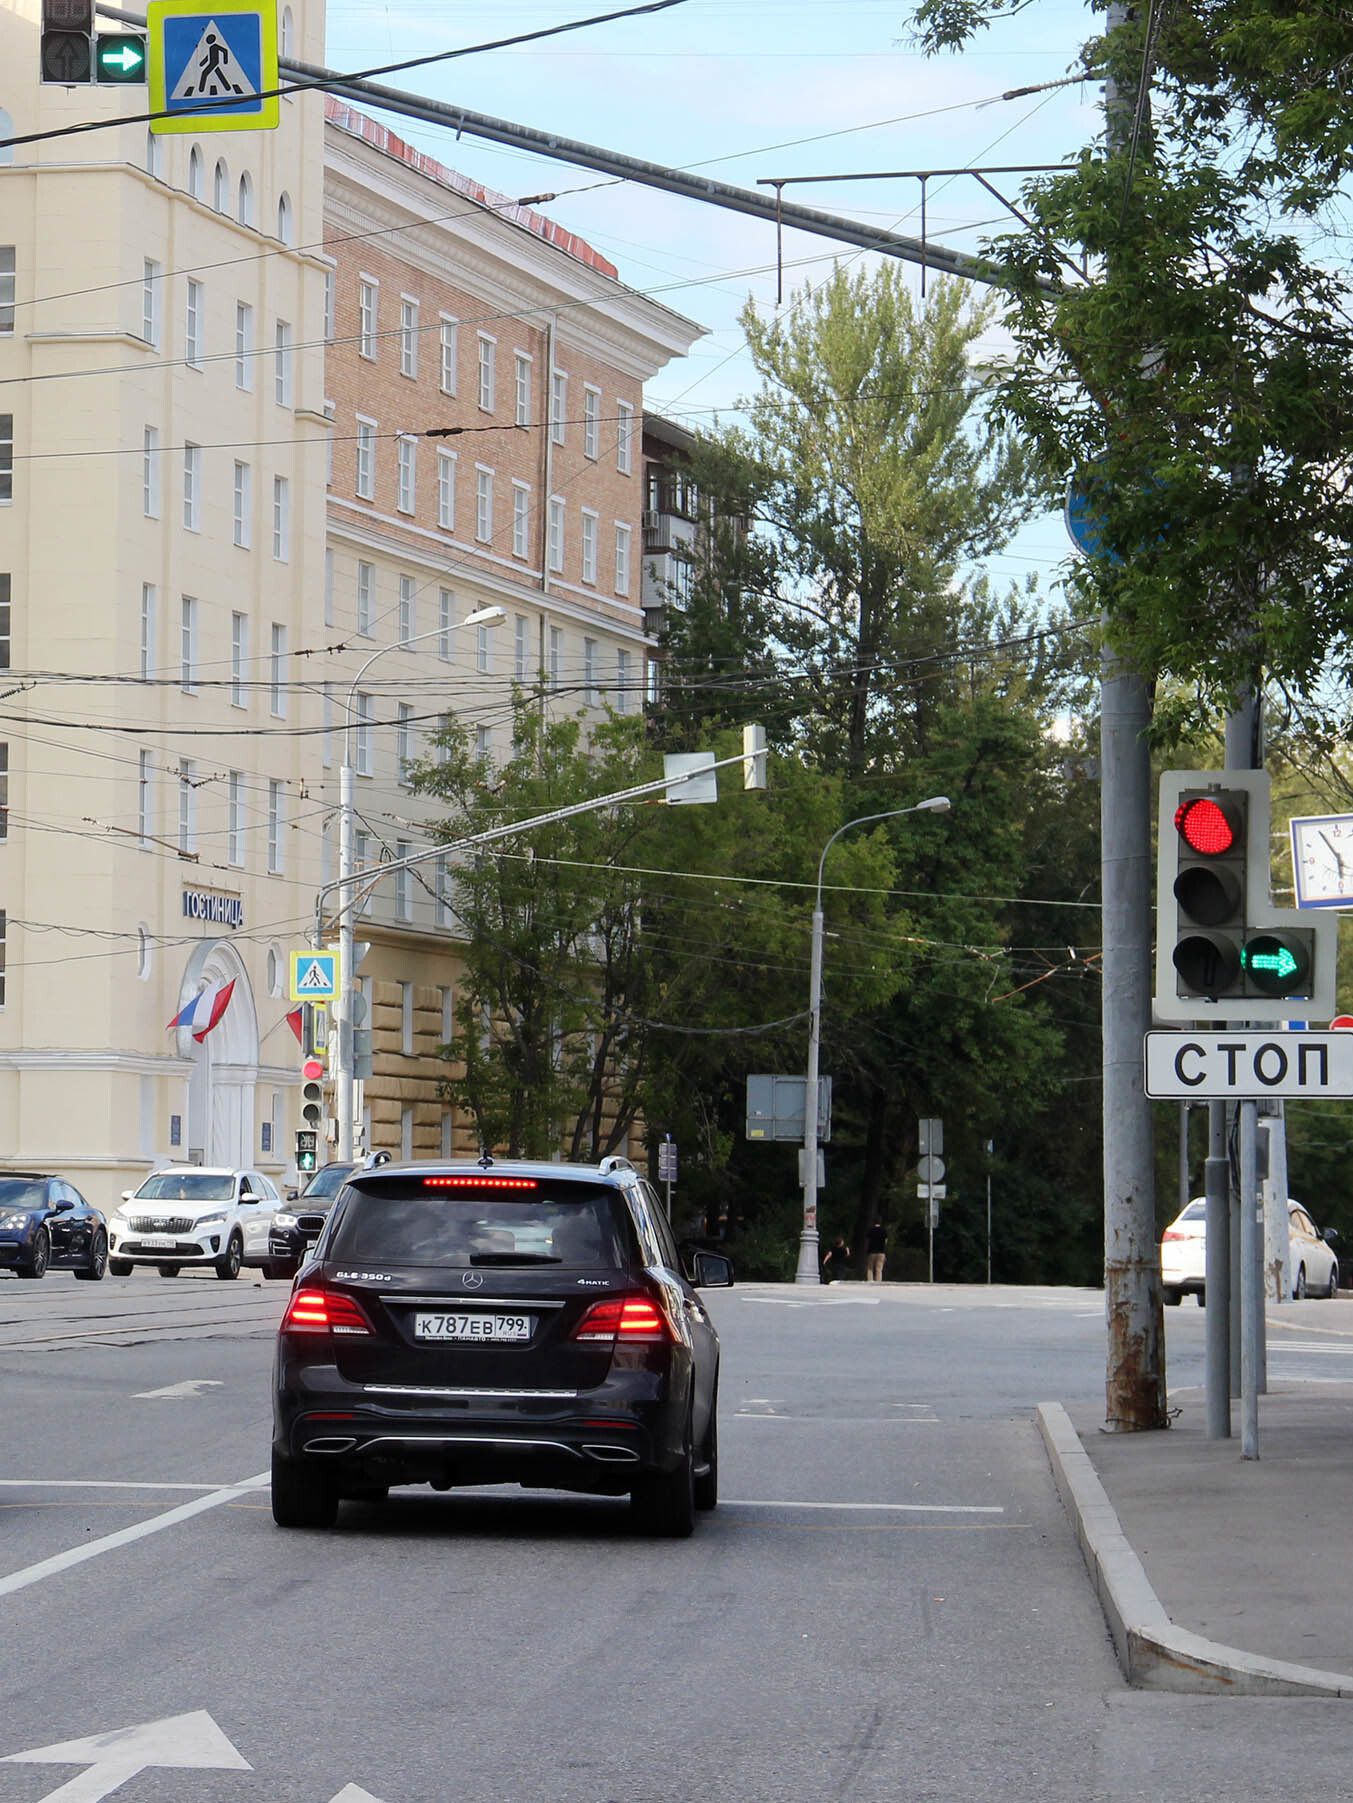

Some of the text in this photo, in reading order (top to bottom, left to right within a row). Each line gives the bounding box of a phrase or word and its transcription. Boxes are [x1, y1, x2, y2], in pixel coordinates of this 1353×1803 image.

[1333, 829, 1342, 837] 12
[185, 891, 244, 930] ГОСТИНИЦА
[1174, 1042, 1329, 1086] СТОП
[336, 1271, 358, 1280] GLE
[577, 1279, 610, 1287] 4MATIC
[422, 1316, 524, 1335] К787ЕВ 799
